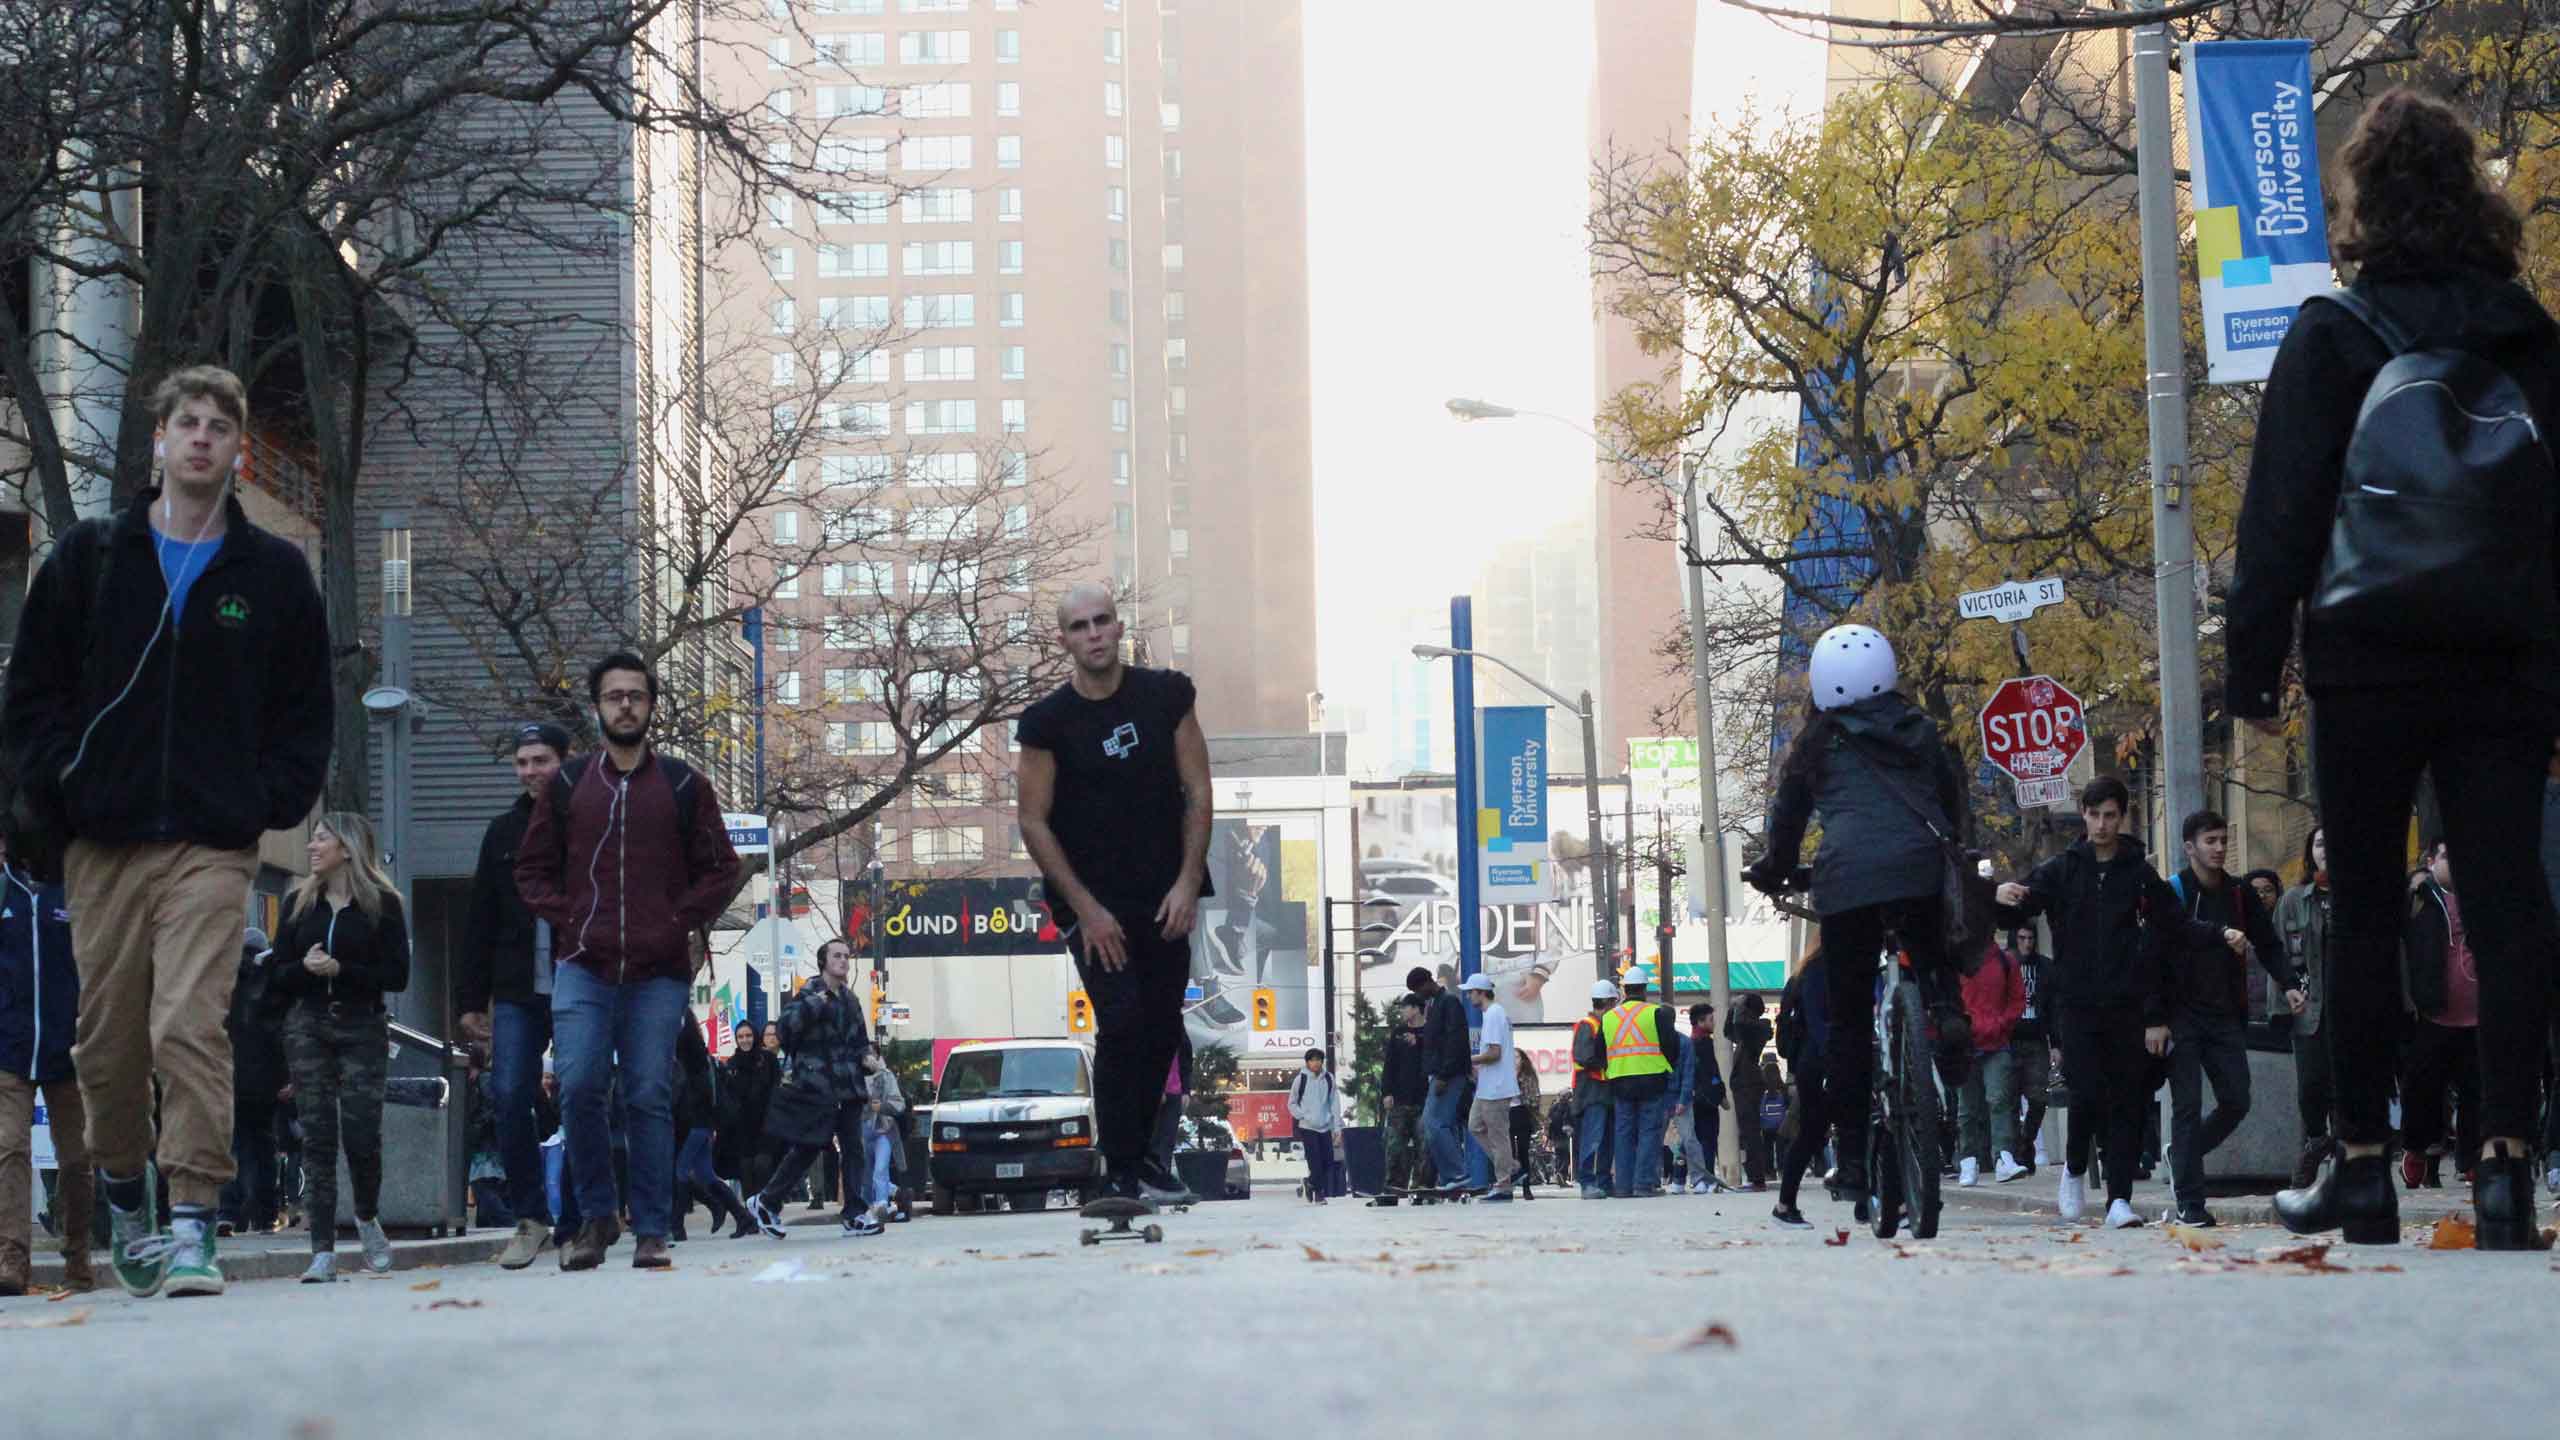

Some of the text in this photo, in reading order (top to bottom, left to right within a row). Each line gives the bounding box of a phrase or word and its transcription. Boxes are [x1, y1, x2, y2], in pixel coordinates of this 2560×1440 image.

[2251, 111, 2288, 237] Ryerson
[2273, 81, 2310, 236] University
[2231, 314, 2289, 332] Ryerson
[1964, 589, 2028, 613] VICTORIA
[1634, 745, 1678, 763] FOR
[1989, 706, 2076, 752] STOP
[1508, 755, 1526, 827] Ryerson
[1522, 739, 1541, 827] University
[1378, 895, 1597, 953] ARDENE
[1264, 1037, 1315, 1048] ALDO
